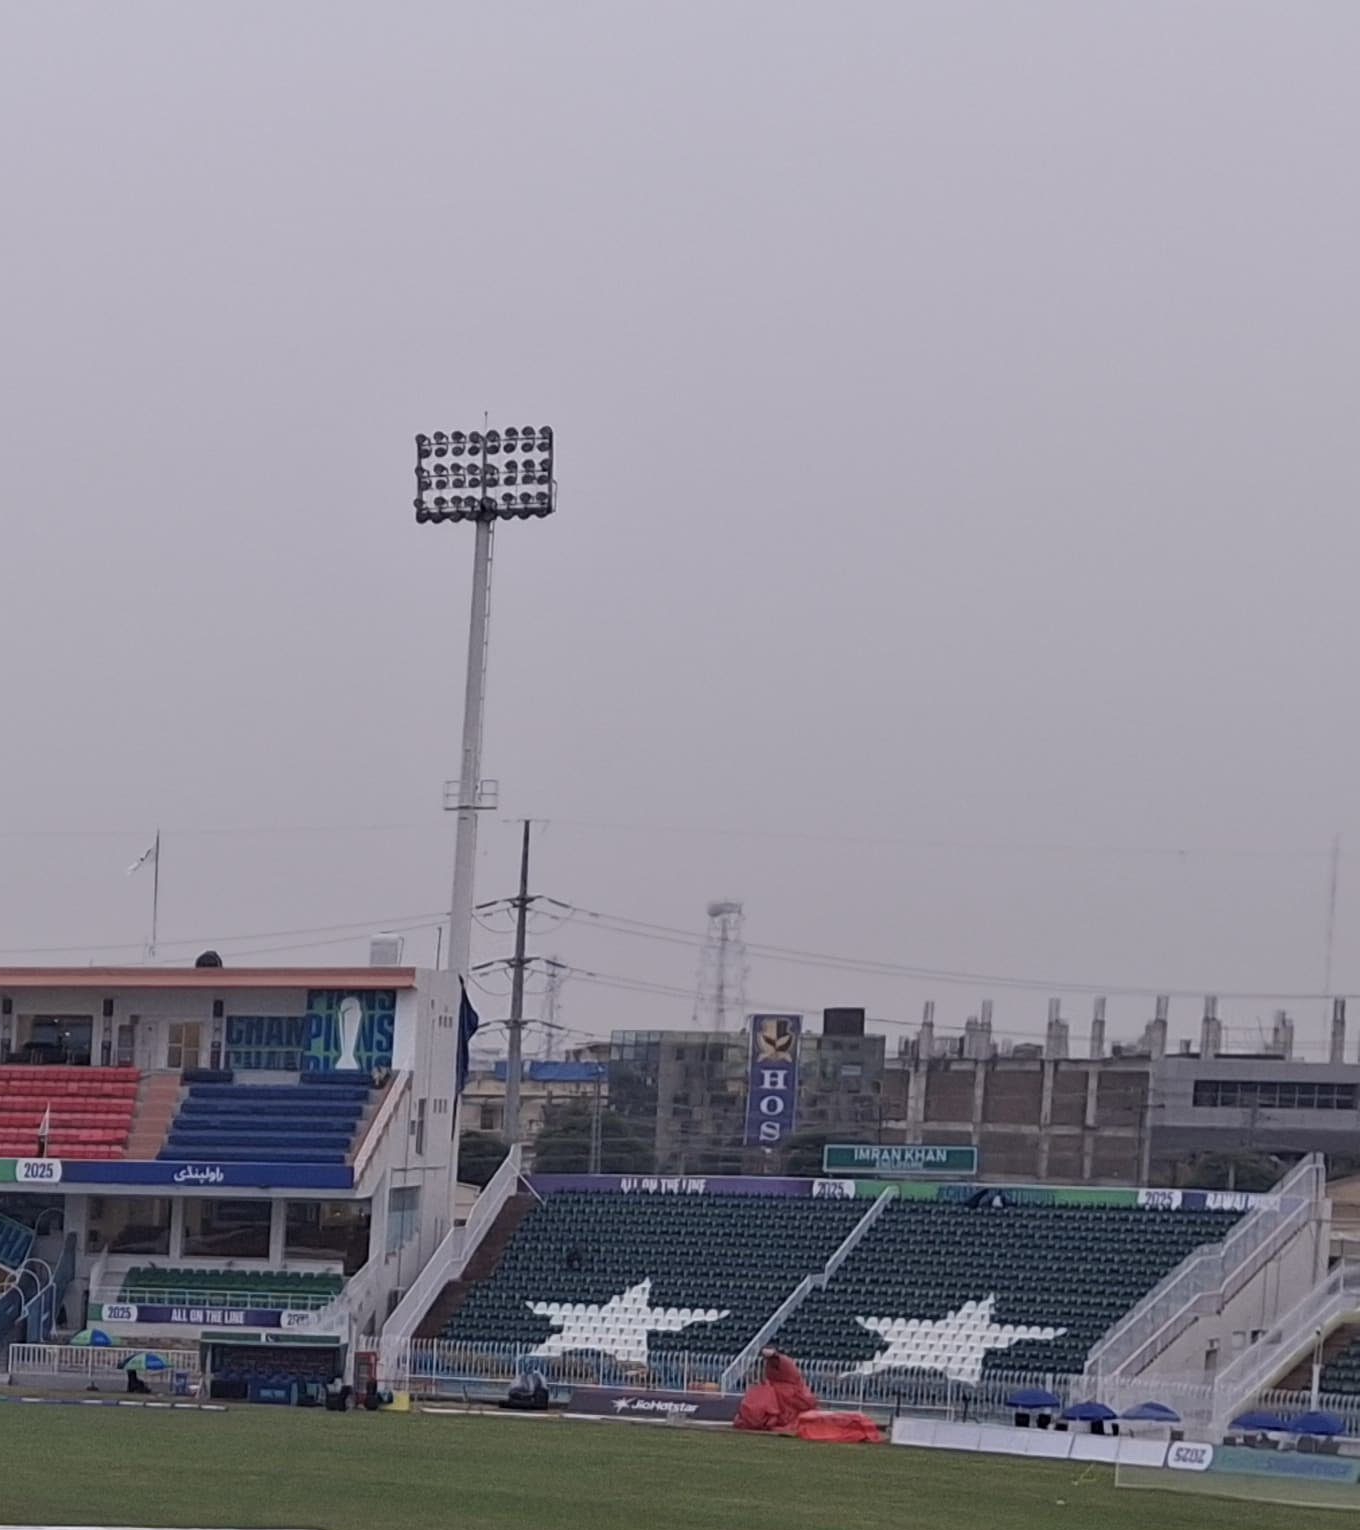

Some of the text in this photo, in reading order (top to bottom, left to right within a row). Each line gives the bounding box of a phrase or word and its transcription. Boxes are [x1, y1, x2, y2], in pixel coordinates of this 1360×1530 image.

[854, 1148, 947, 1163] IMRAN KHAN
[23, 1162, 53, 1179] 2025
[107, 1305, 131, 1319] 2025
[171, 1308, 245, 1325] ALL ON THE LINE
[631, 1399, 699, 1413] JioHotstar
